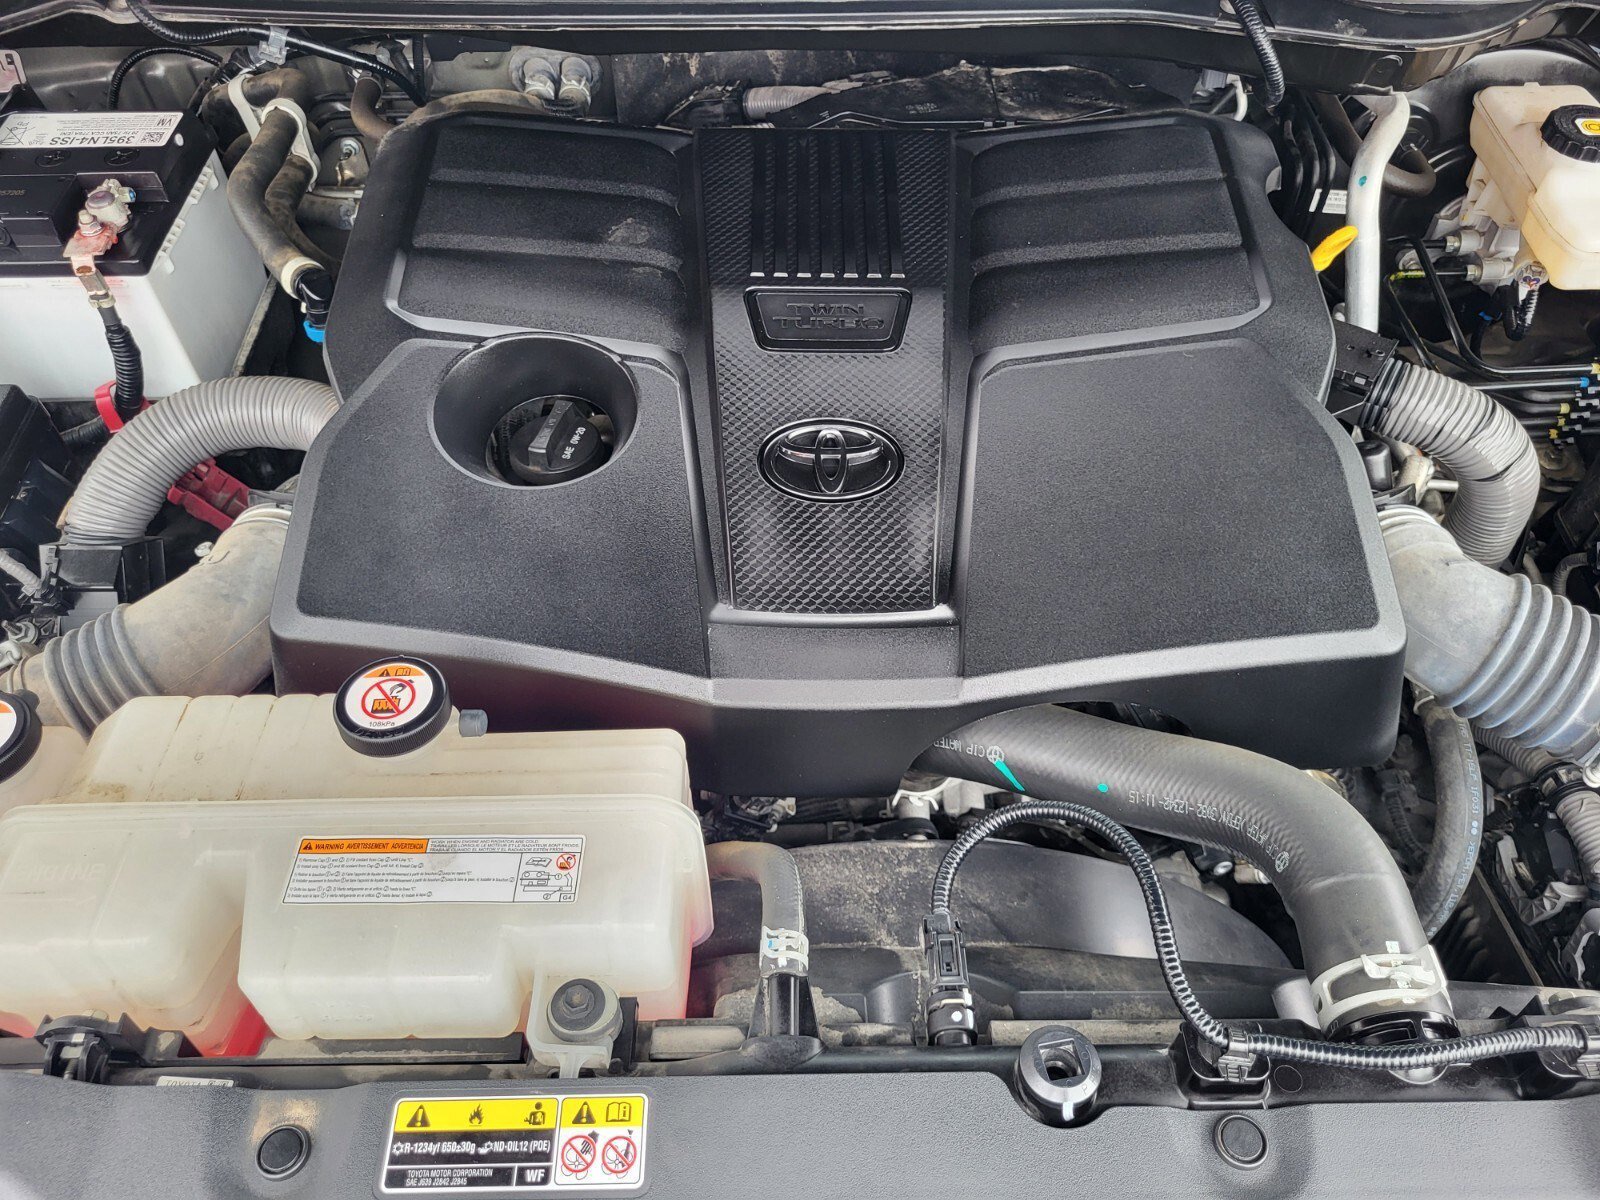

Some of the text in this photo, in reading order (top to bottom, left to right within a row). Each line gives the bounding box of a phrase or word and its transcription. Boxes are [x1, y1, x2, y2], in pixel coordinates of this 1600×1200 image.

[786, 303, 864, 316] TWIN
[772, 316, 885, 329] TURBO
[562, 426, 586, 460] SAE 0W-20
[315, 842, 424, 850] WARNING AVERTISSEMENT ADVERTENCIA
[404, 1141, 441, 1156] R-1234yf
[441, 1141, 476, 1155] 650±30g
[529, 1139, 551, 1154] (POE)
[406, 1177, 418, 1186] SAE
[432, 1177, 450, 1186] J2842
[450, 1177, 468, 1185] J2845
[407, 1168, 545, 1182] TOYOTA MOTOR CORPORATION WF
